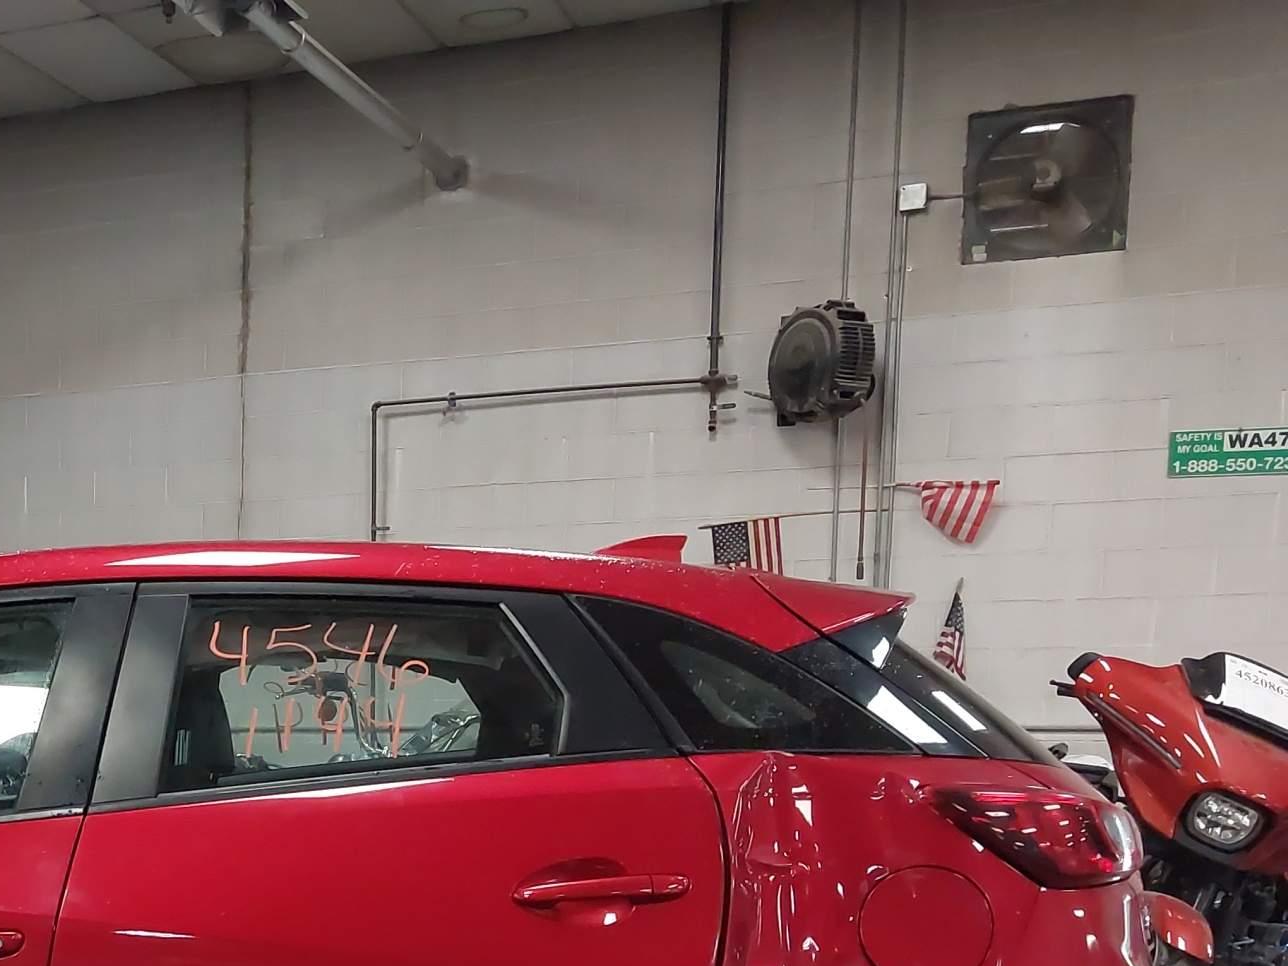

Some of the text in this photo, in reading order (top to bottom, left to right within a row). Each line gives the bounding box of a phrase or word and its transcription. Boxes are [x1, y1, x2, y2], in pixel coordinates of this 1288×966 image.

[1175, 432, 1223, 442] SAFETY IS
[1177, 444, 1220, 454] MY GOAL
[209, 621, 430, 686] 4546
